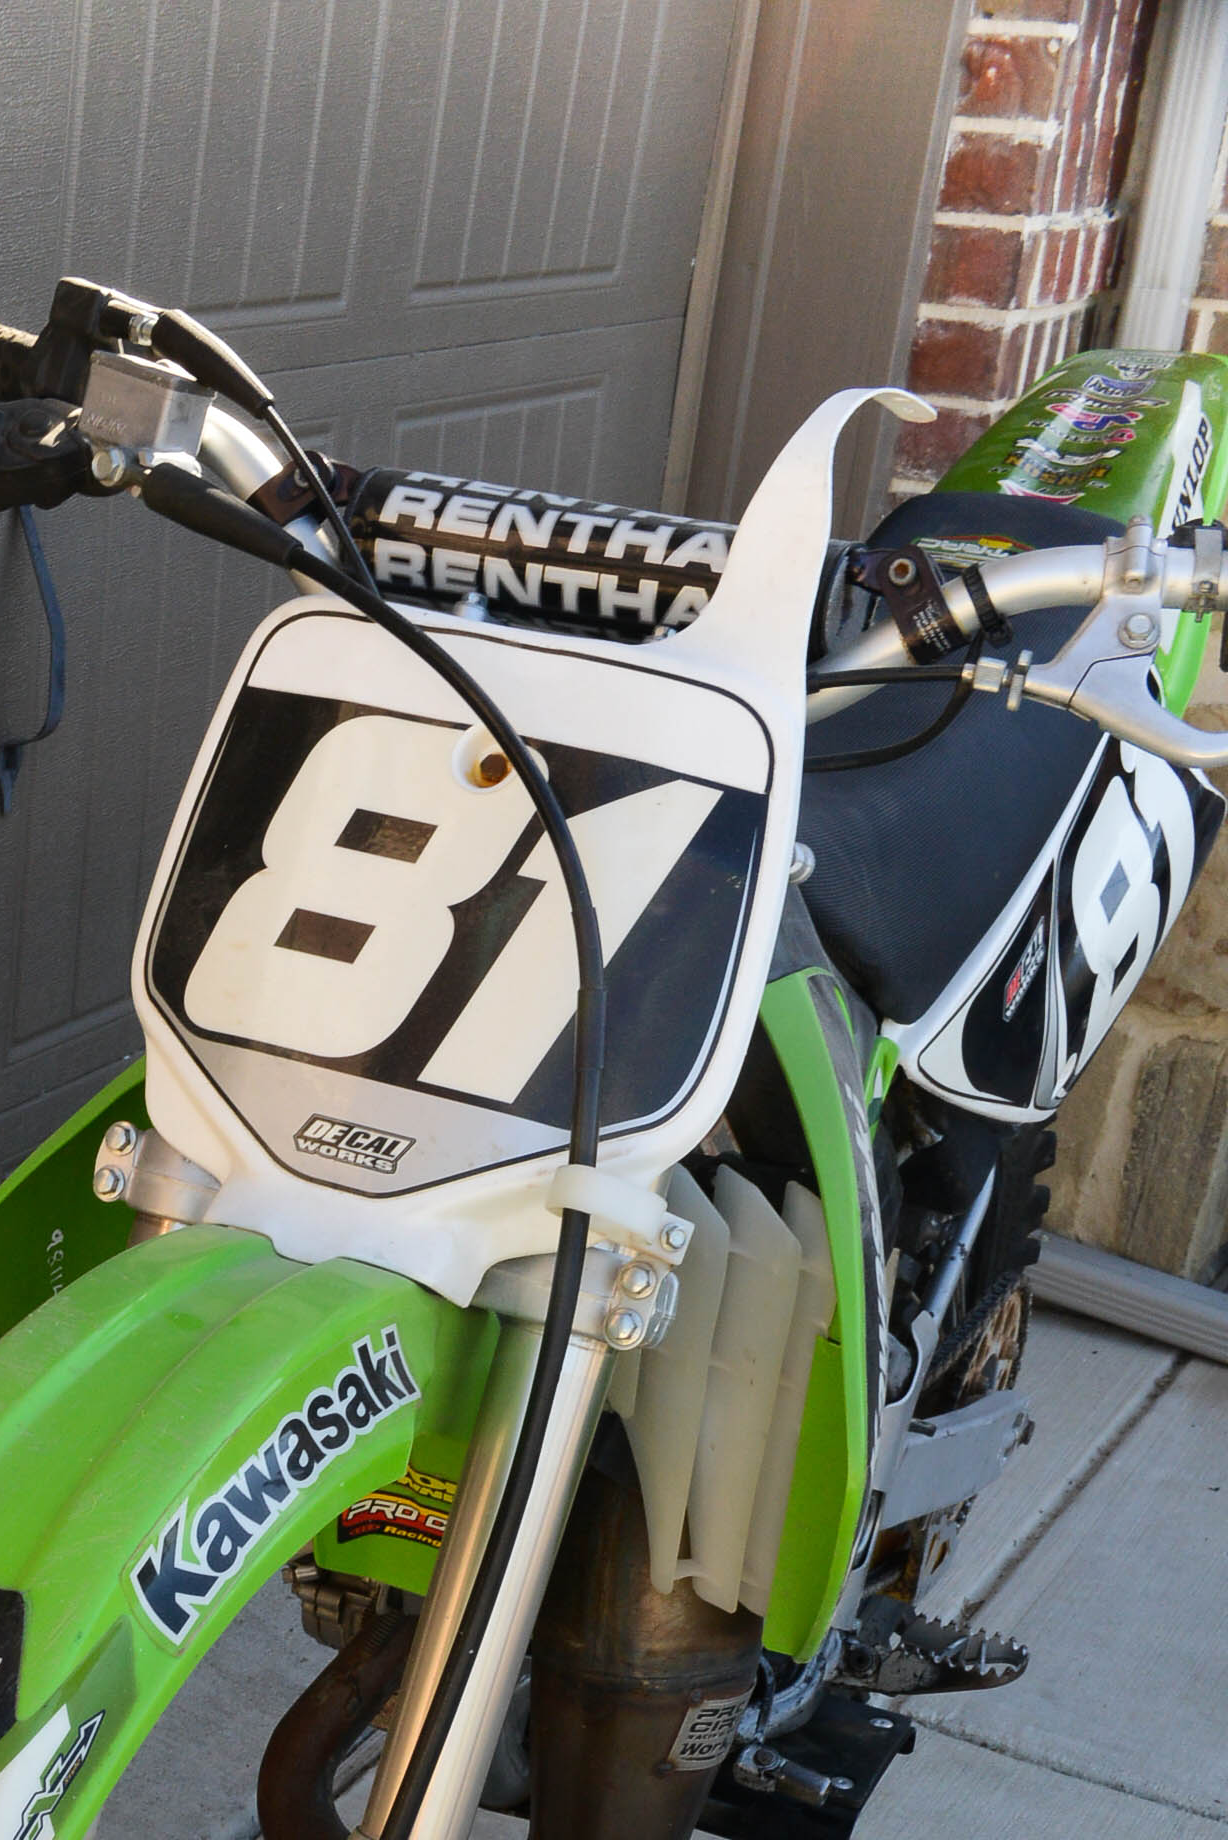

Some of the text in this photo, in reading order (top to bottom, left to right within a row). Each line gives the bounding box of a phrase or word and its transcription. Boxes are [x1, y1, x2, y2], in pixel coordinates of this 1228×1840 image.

[1171, 418, 1210, 528] UNLOP
[379, 485, 732, 573] RENTHA
[374, 538, 713, 629] RENTHA
[183, 714, 723, 1104] 81
[297, 1138, 394, 1172] WORKS
[304, 1119, 400, 1158] DECAL
[133, 1327, 419, 1641] Kawasaki
[347, 1499, 419, 1521] PRO
[383, 1525, 442, 1548] Racing
[680, 1738, 727, 1755] Work
